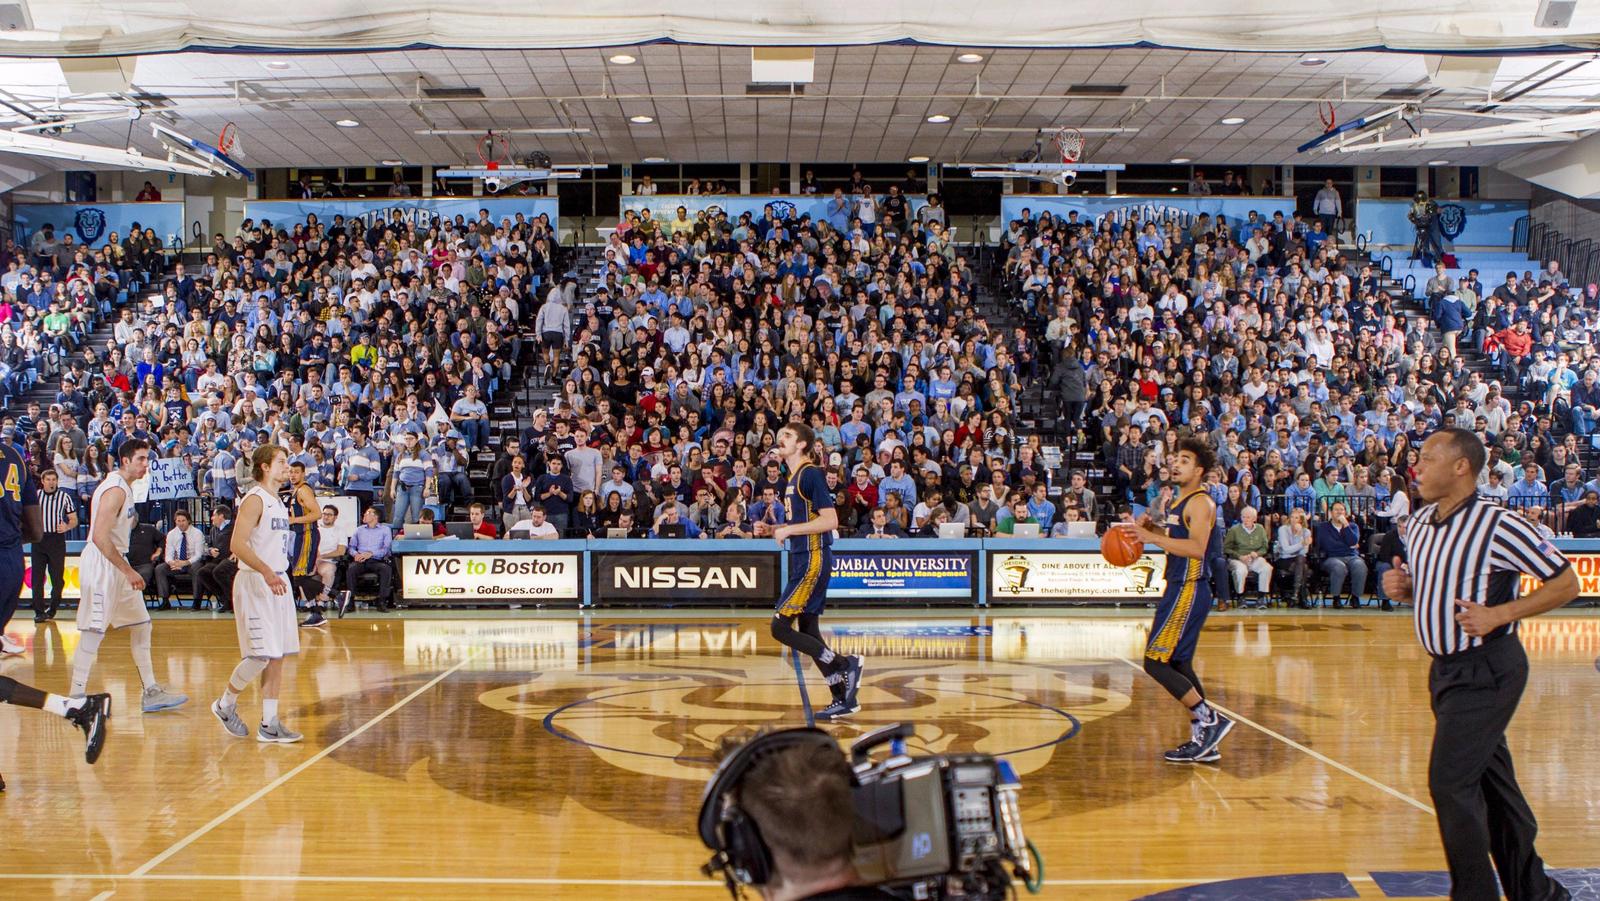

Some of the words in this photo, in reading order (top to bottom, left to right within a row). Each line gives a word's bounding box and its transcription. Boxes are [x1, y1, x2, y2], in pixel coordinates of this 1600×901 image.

[151, 460, 169, 471] Our
[163, 469, 188, 482] better
[150, 483, 171, 494] than
[415, 558, 461, 575] NYC
[466, 559, 487, 575] to
[491, 558, 565, 575] Boston
[881, 558, 969, 571] UNIVERSITY
[614, 567, 757, 588] NISSAN
[914, 570, 967, 578] Management
[476, 585, 554, 595] GoBuses.com
[1041, 587, 1120, 595] theheightsnyc.com
